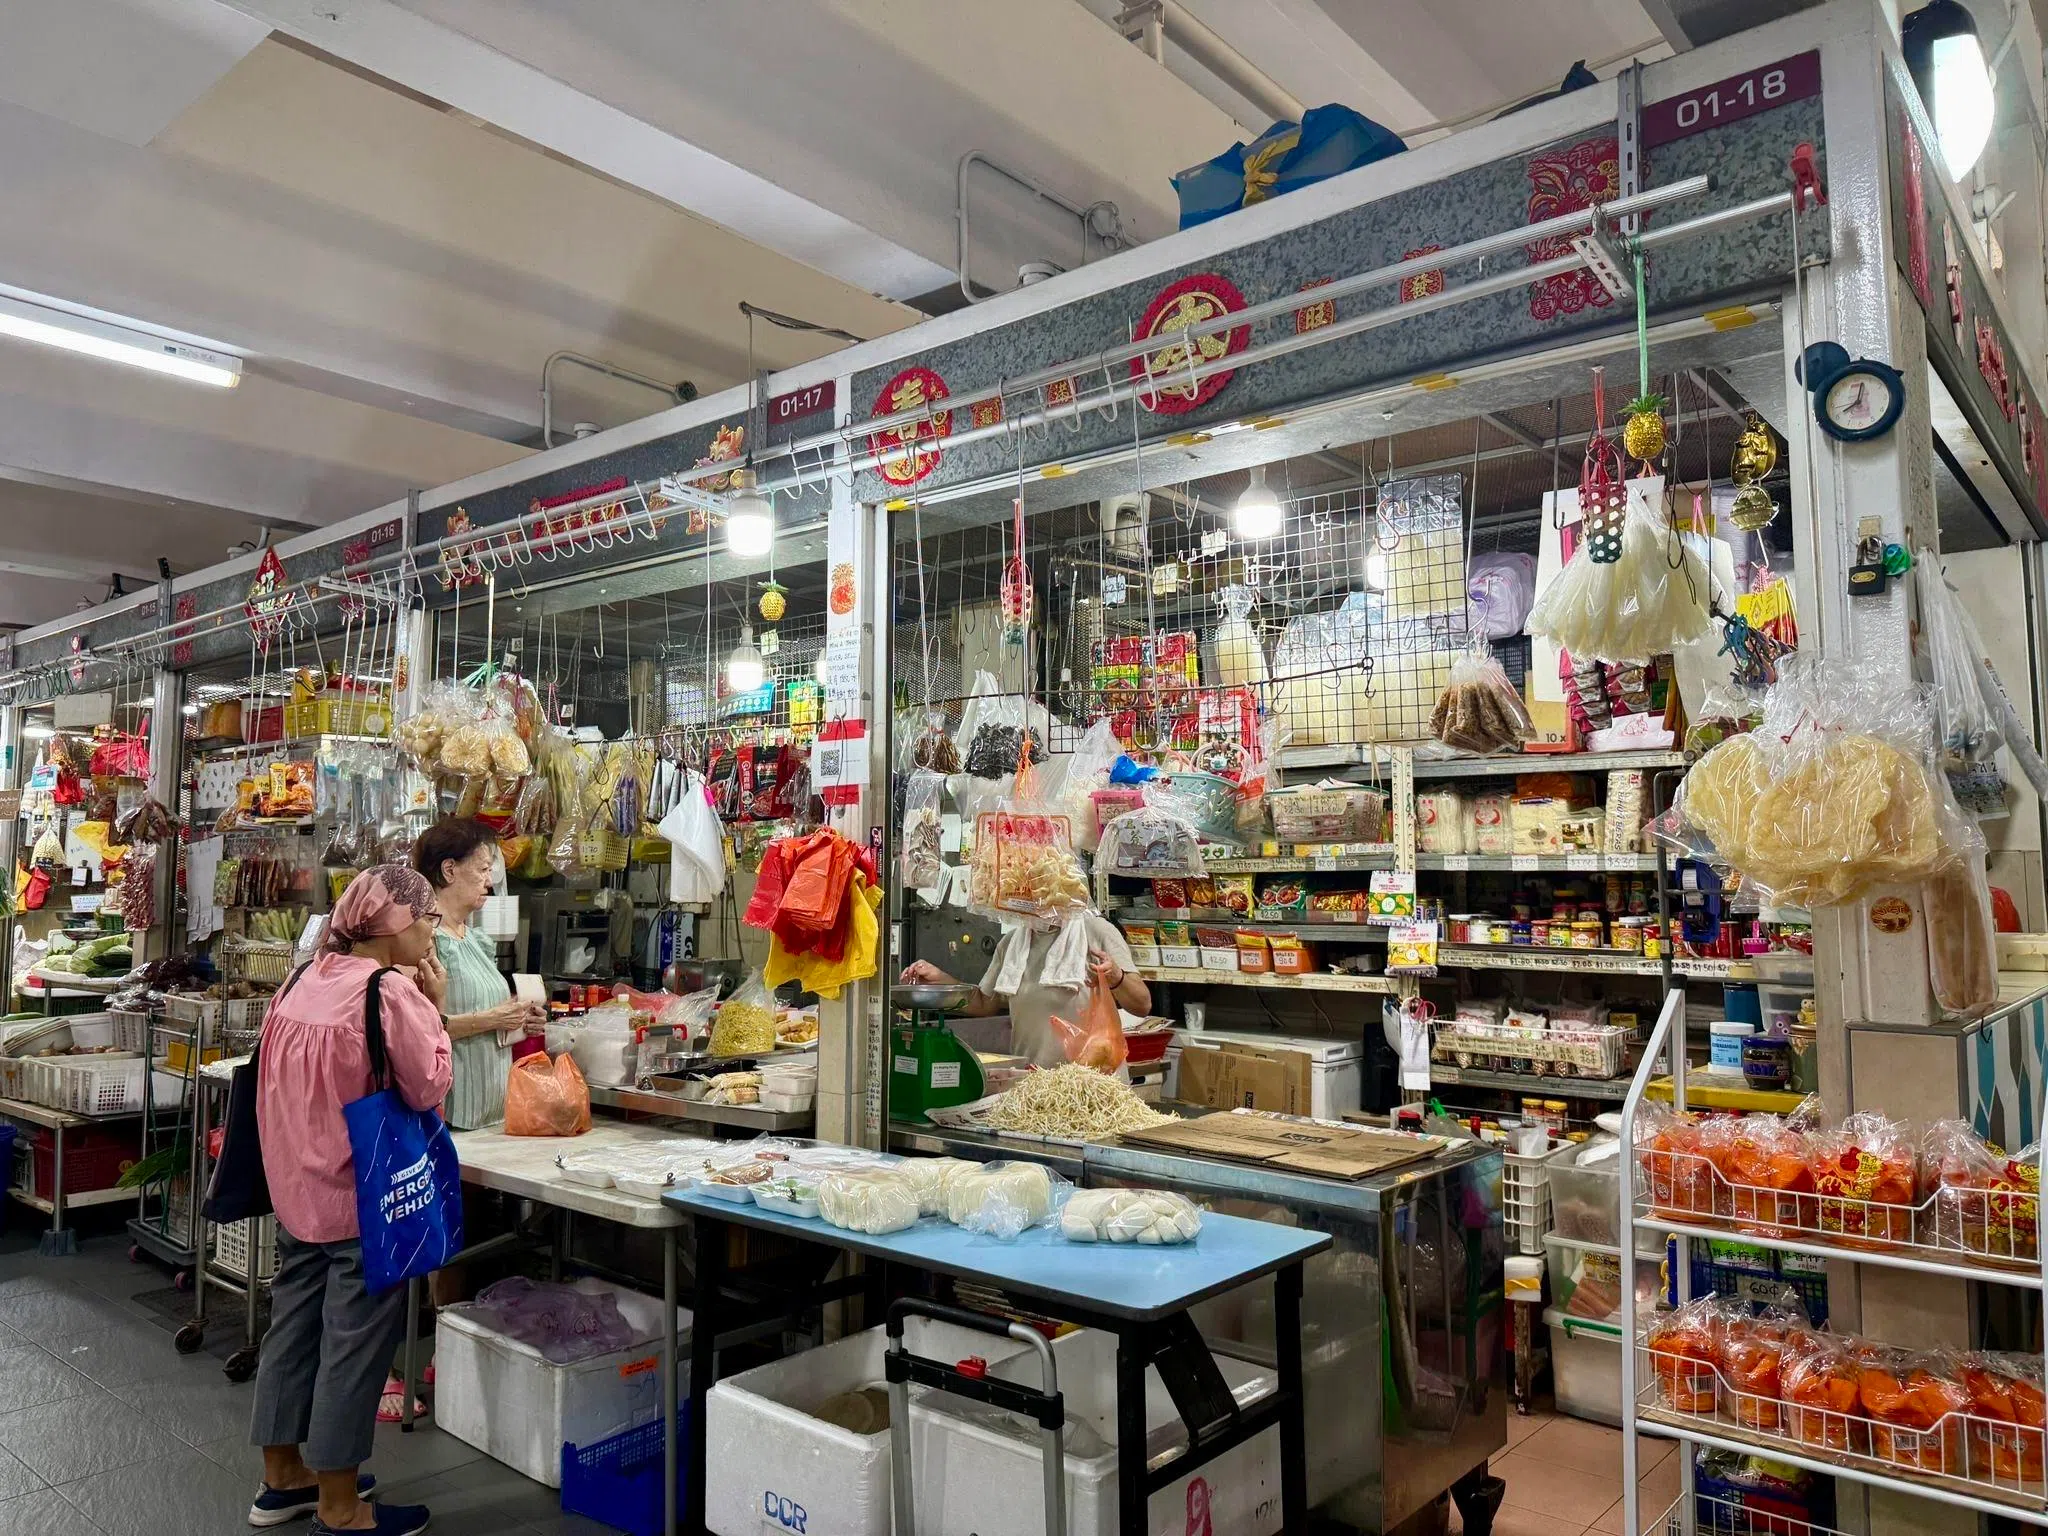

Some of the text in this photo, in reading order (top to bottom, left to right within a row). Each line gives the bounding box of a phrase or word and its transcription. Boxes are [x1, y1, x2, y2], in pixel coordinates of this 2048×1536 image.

[1677, 70, 1786, 128] 01-18
[780, 387, 822, 417] 01-17
[371, 523, 395, 543] 01-16
[1546, 732, 1557, 742] 10
[1614, 821, 1623, 850] BERAS
[1261, 910, 1280, 919] $2.50
[401, 1168, 416, 1178] GIVE
[1749, 1281, 1778, 1297] 60¢
